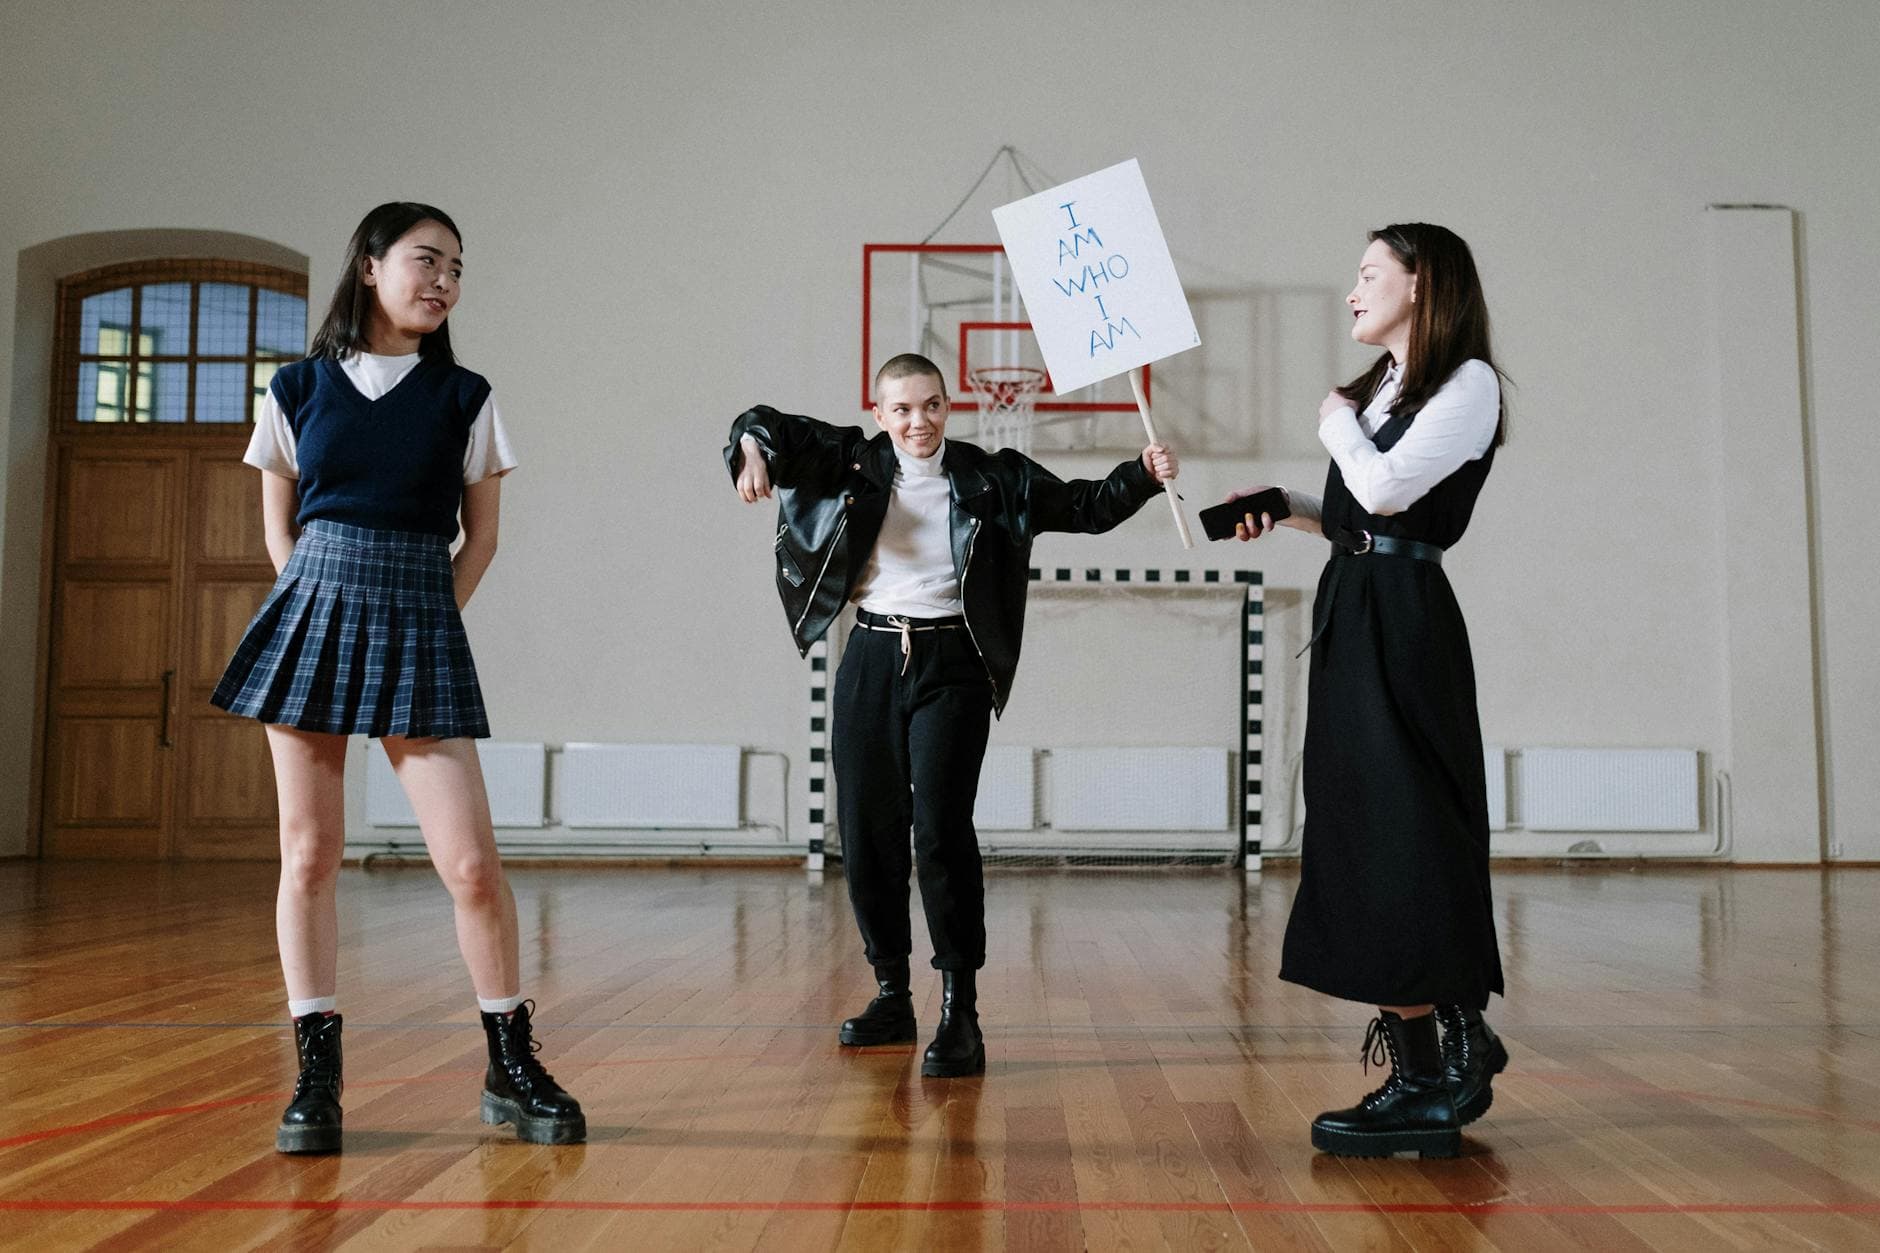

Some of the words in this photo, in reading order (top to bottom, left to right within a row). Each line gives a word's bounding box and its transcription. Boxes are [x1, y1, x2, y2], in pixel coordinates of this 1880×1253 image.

[1059, 201, 1081, 230] I
[1058, 227, 1104, 266] AM
[1052, 254, 1129, 297] WHO
[1094, 294, 1110, 321] I
[1089, 316, 1142, 359] AM
